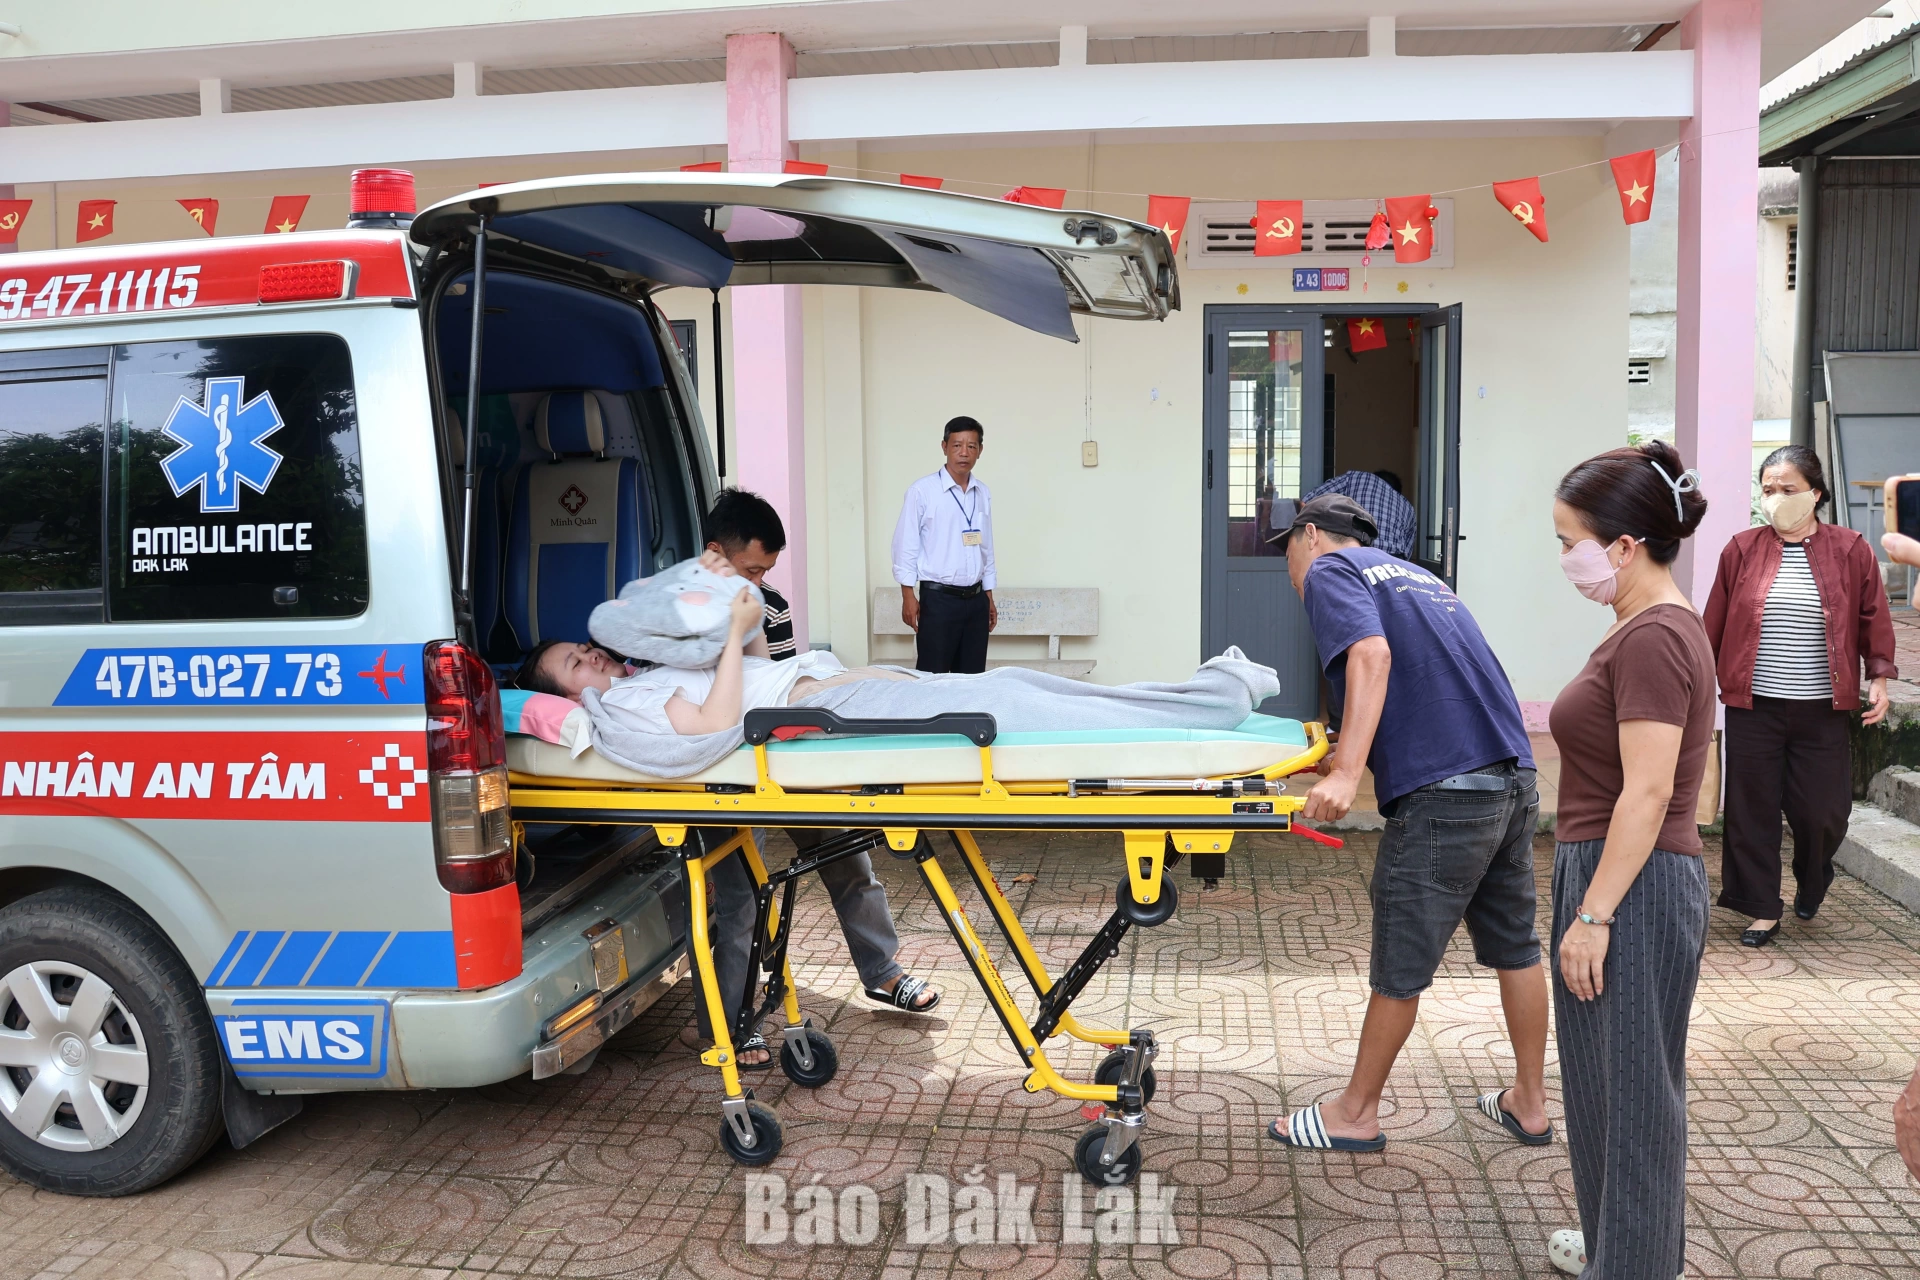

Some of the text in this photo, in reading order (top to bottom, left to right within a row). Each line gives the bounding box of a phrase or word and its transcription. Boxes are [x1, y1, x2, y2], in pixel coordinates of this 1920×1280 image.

[1307, 274, 1318, 287] 43
[550, 517, 597, 527] Minh Quân
[132, 523, 312, 555] AMBULANCE
[133, 558, 189, 572] DAK LAK
[96, 653, 343, 698] 47B-027.73
[1, 750, 326, 800] NHÂN AN TÂM
[224, 1020, 365, 1060] EMS
